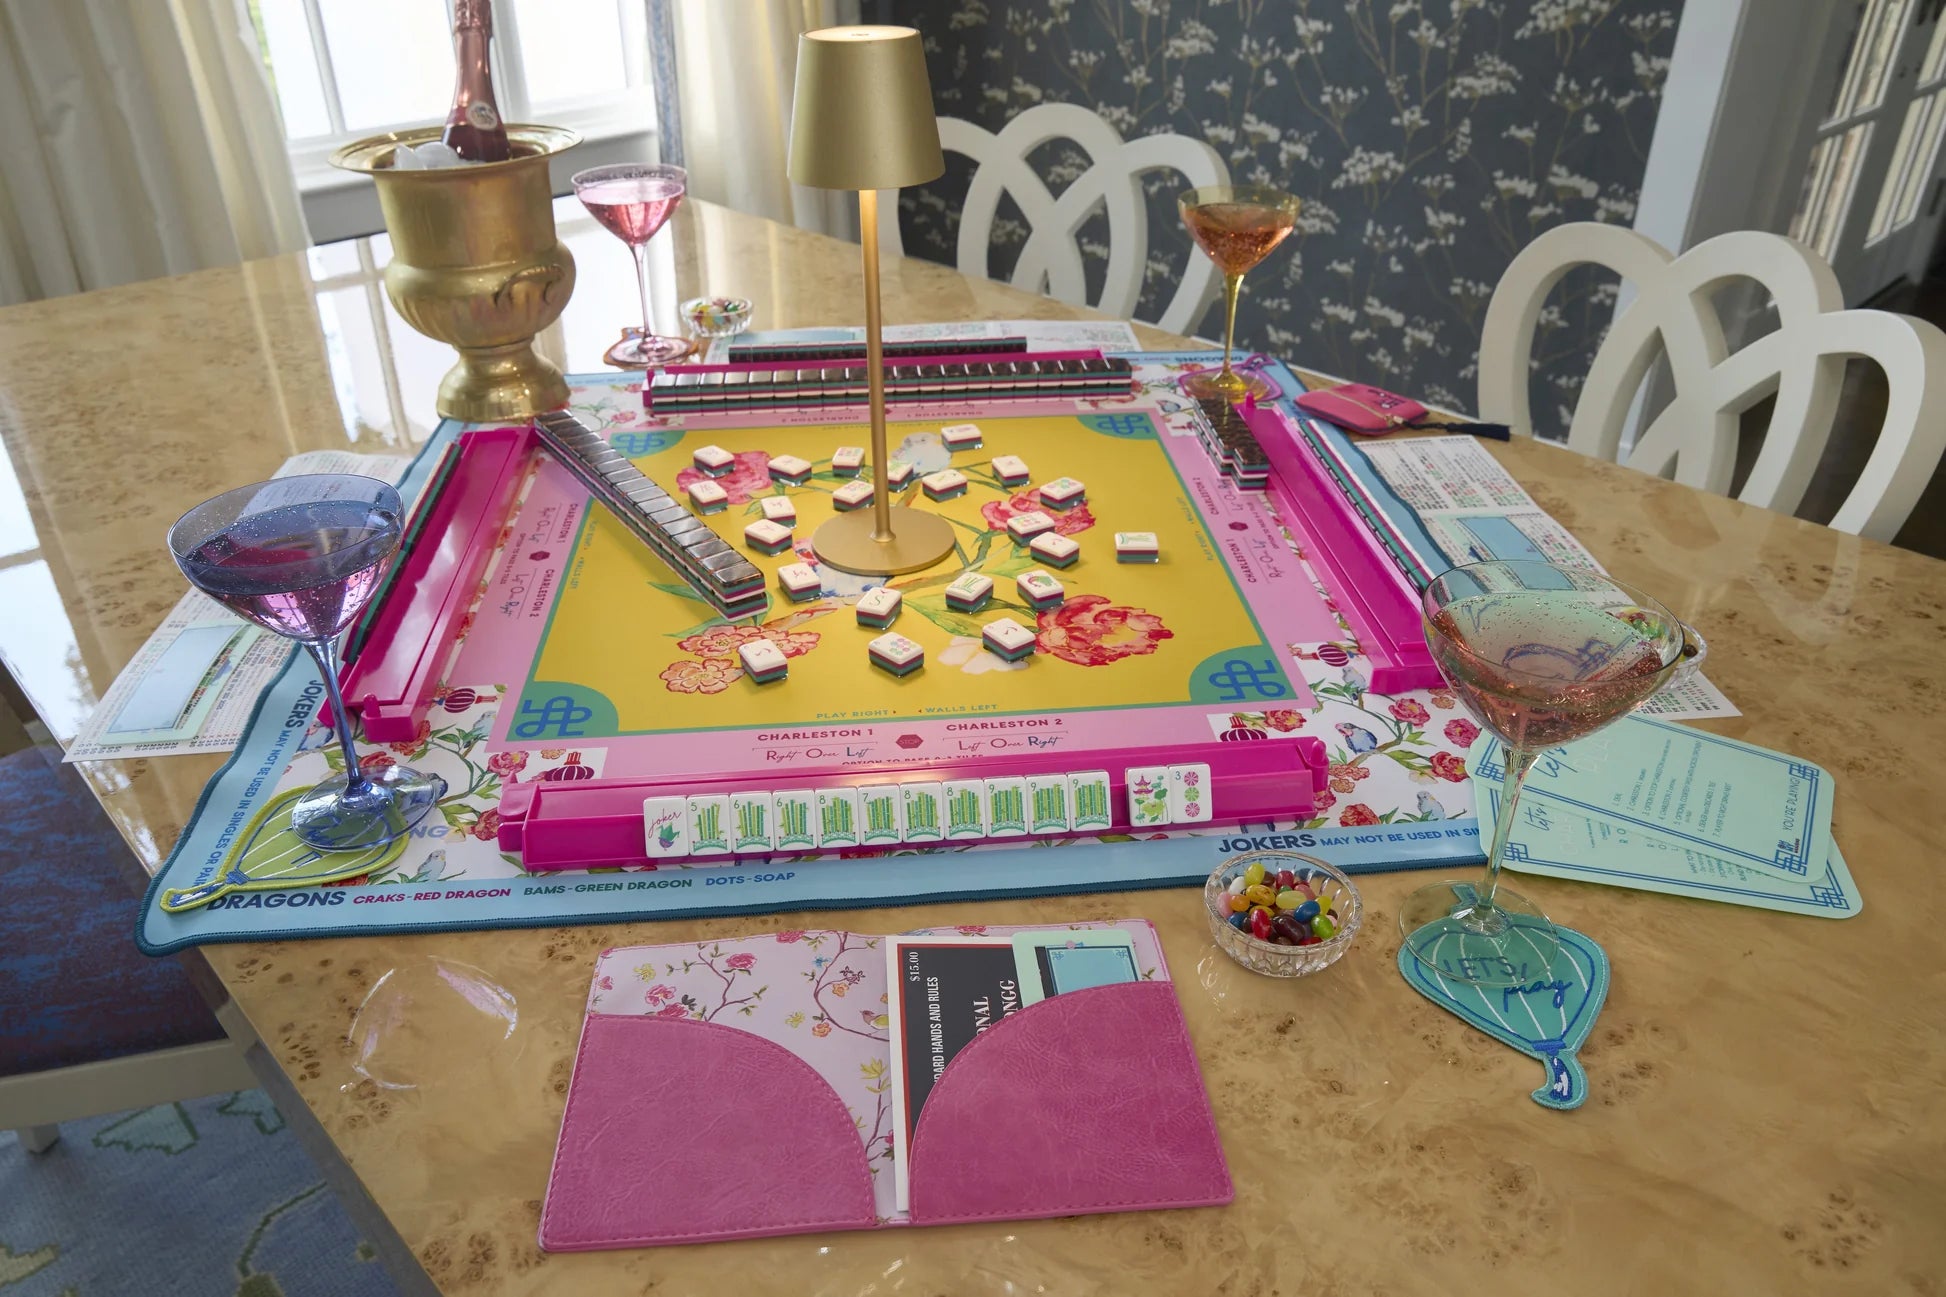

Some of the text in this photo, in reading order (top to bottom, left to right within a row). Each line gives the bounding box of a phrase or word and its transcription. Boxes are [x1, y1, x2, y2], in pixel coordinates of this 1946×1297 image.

[284, 679, 324, 729] JOKERS
[925, 705, 966, 713] WALLS
[852, 709, 889, 717] RIGHT
[946, 718, 1063, 731] CHARLESTON 2
[277, 729, 292, 748] MAY
[757, 729, 862, 742] CHARLESTON
[958, 740, 986, 752] Left
[1028, 735, 1065, 749] Right
[266, 749, 282, 769] NOT
[766, 750, 802, 763] Right
[846, 746, 875, 758] Left
[262, 765, 272, 776] BE
[1175, 770, 1182, 781] 3
[248, 775, 267, 797] USED
[988, 783, 995, 794] 9
[1030, 781, 1037, 792] 9
[1072, 778, 1079, 789] 9
[862, 792, 869, 803] 7
[904, 789, 911, 799] 8
[946, 786, 953, 797] 8
[240, 797, 252, 810] IN
[733, 799, 740, 809] 6
[776, 797, 783, 807] 6
[819, 794, 826, 804] 8
[690, 801, 698, 812] 5
[217, 808, 246, 849] SINGLES
[648, 807, 682, 839] joker
[1218, 833, 1317, 853] JOKERS
[1320, 835, 1351, 847] MAY
[1355, 833, 1385, 844] NOT
[1387, 832, 1404, 843] BE
[1408, 830, 1442, 841] USED
[1446, 828, 1461, 838] IN
[205, 851, 223, 865] OR
[627, 878, 693, 891] DRAGON
[207, 890, 347, 911] DRAGONS
[444, 888, 512, 901] DRAGON
[908, 951, 920, 983] $15.00
[926, 976, 940, 1002] RULES
[928, 1003, 942, 1022] AND
[930, 1023, 944, 1054] HANDS
